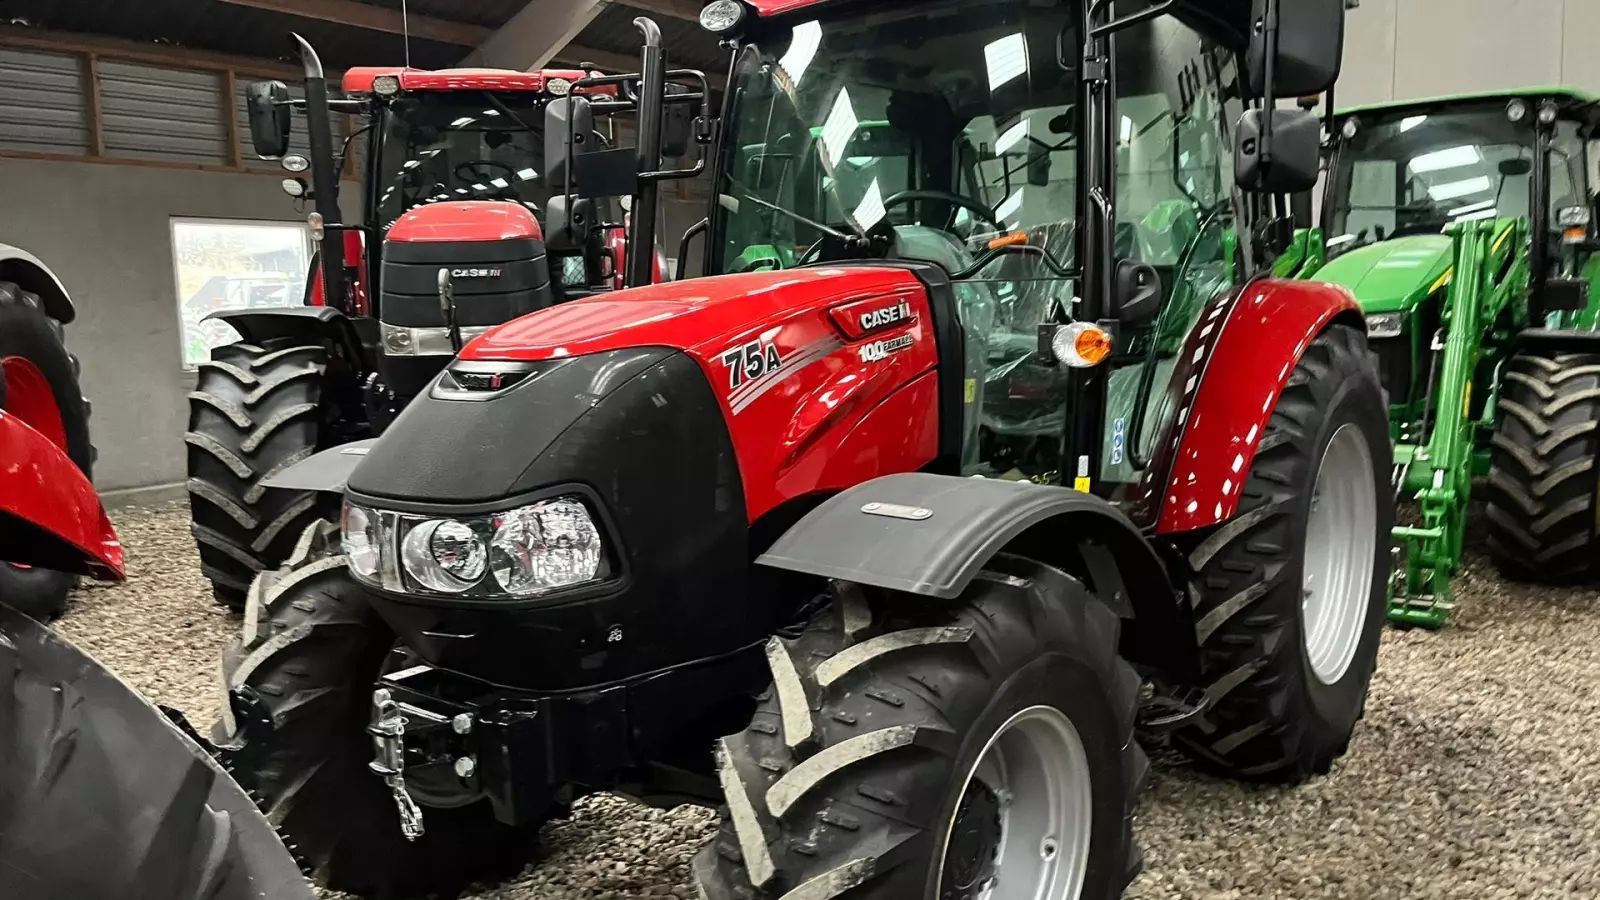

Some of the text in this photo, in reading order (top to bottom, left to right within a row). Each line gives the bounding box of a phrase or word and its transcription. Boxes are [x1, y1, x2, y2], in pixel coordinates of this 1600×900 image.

[451, 268, 488, 278] CASE
[860, 305, 899, 329] CASE
[722, 340, 783, 389] 75A
